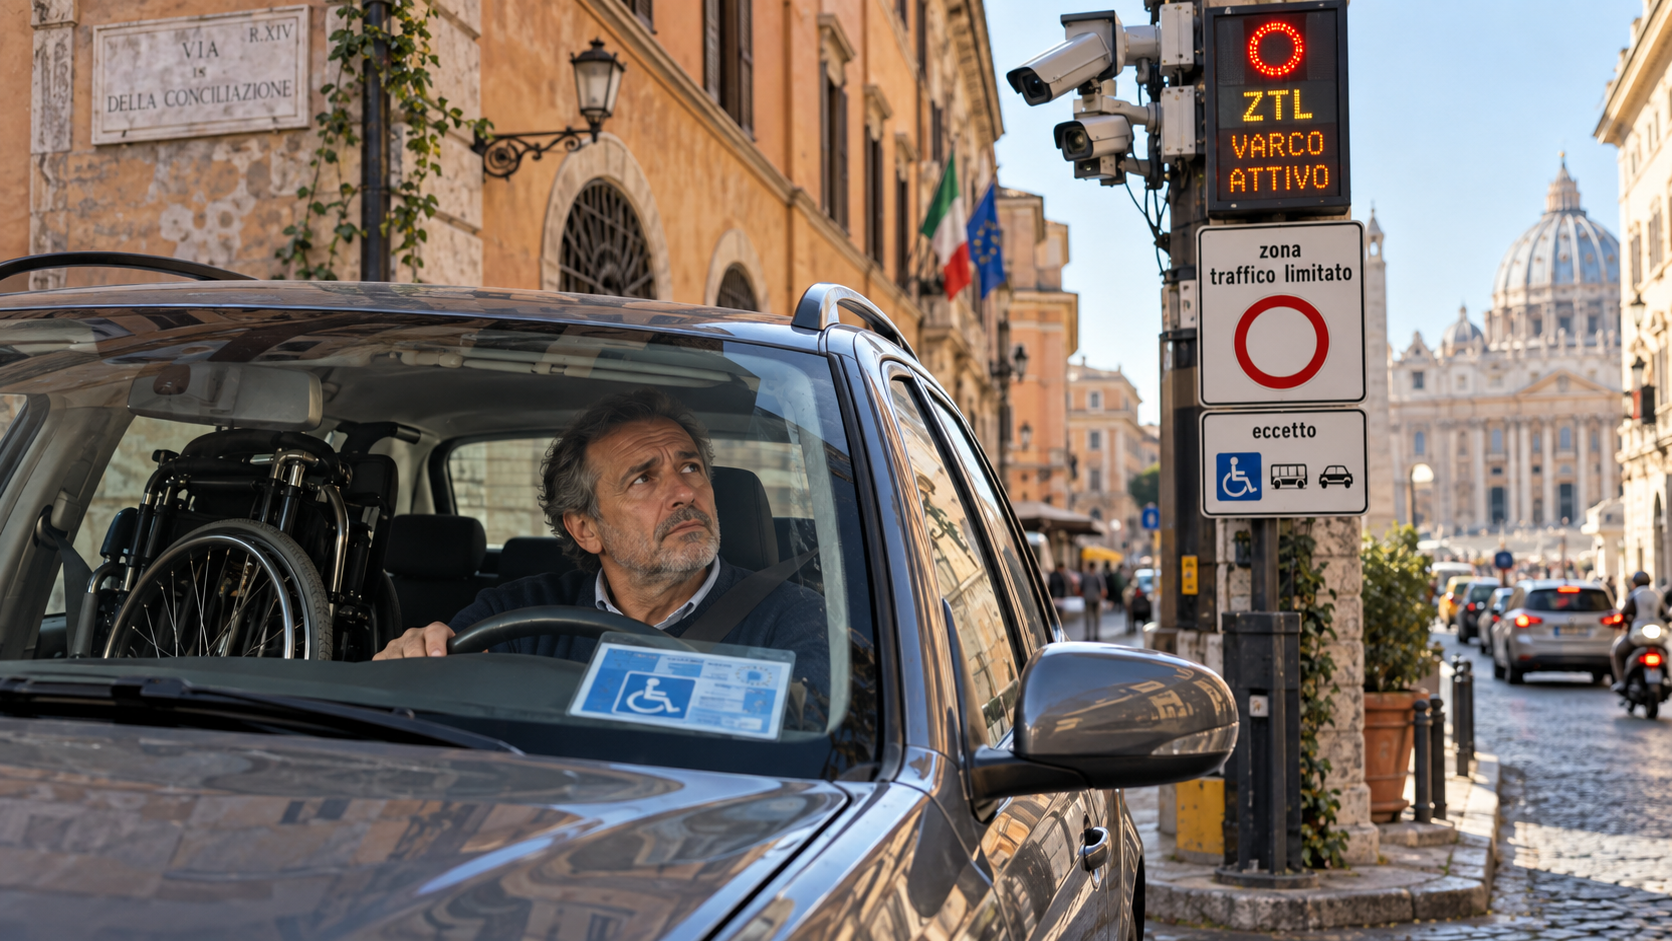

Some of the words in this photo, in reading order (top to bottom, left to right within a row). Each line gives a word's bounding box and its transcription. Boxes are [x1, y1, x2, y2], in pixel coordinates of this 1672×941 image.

[249, 24, 293, 43] R.XIV
[182, 40, 219, 59] VIA
[107, 93, 157, 113] DELLA
[164, 79, 292, 108] CONCILIAZIONE
[1243, 89, 1313, 122] ZTL
[1232, 131, 1324, 159] VARCO
[1230, 164, 1329, 193] ATTIVO
[1259, 243, 1302, 259] zona
[1210, 266, 1276, 285] traffico
[1284, 263, 1353, 283] limitato
[1252, 422, 1317, 439] eccetto
